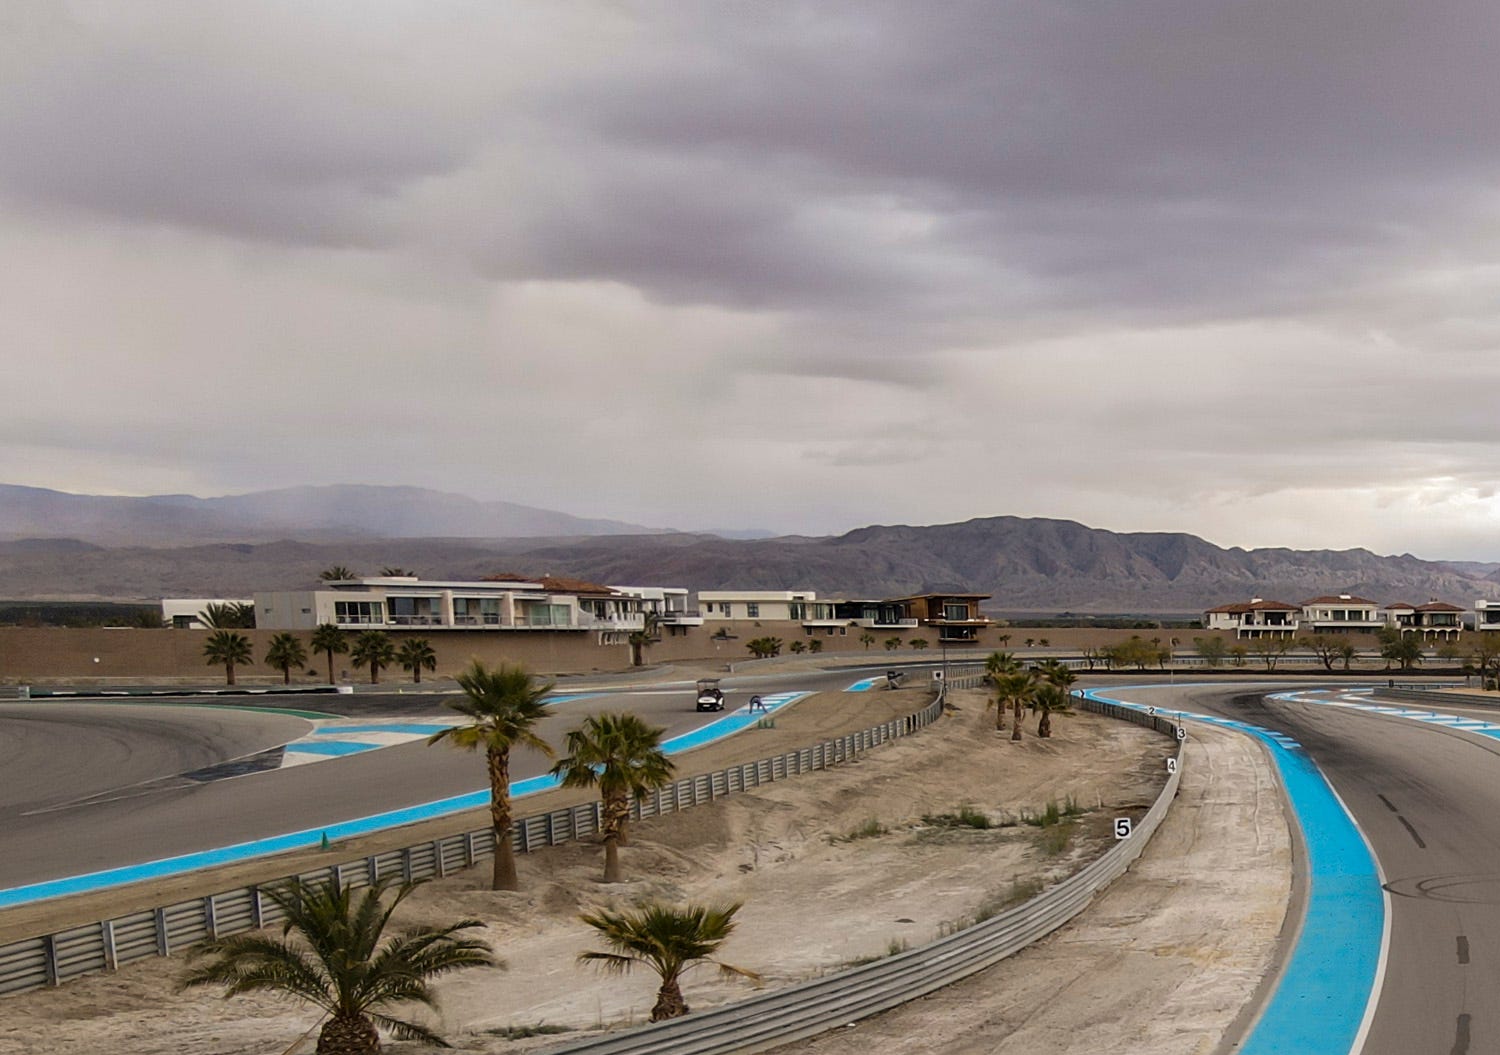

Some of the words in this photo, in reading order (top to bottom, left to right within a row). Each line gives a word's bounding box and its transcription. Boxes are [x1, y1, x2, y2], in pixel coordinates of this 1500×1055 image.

[1178, 728, 1186, 739] 3
[1168, 760, 1176, 772] 4
[1116, 819, 1130, 837] 5
